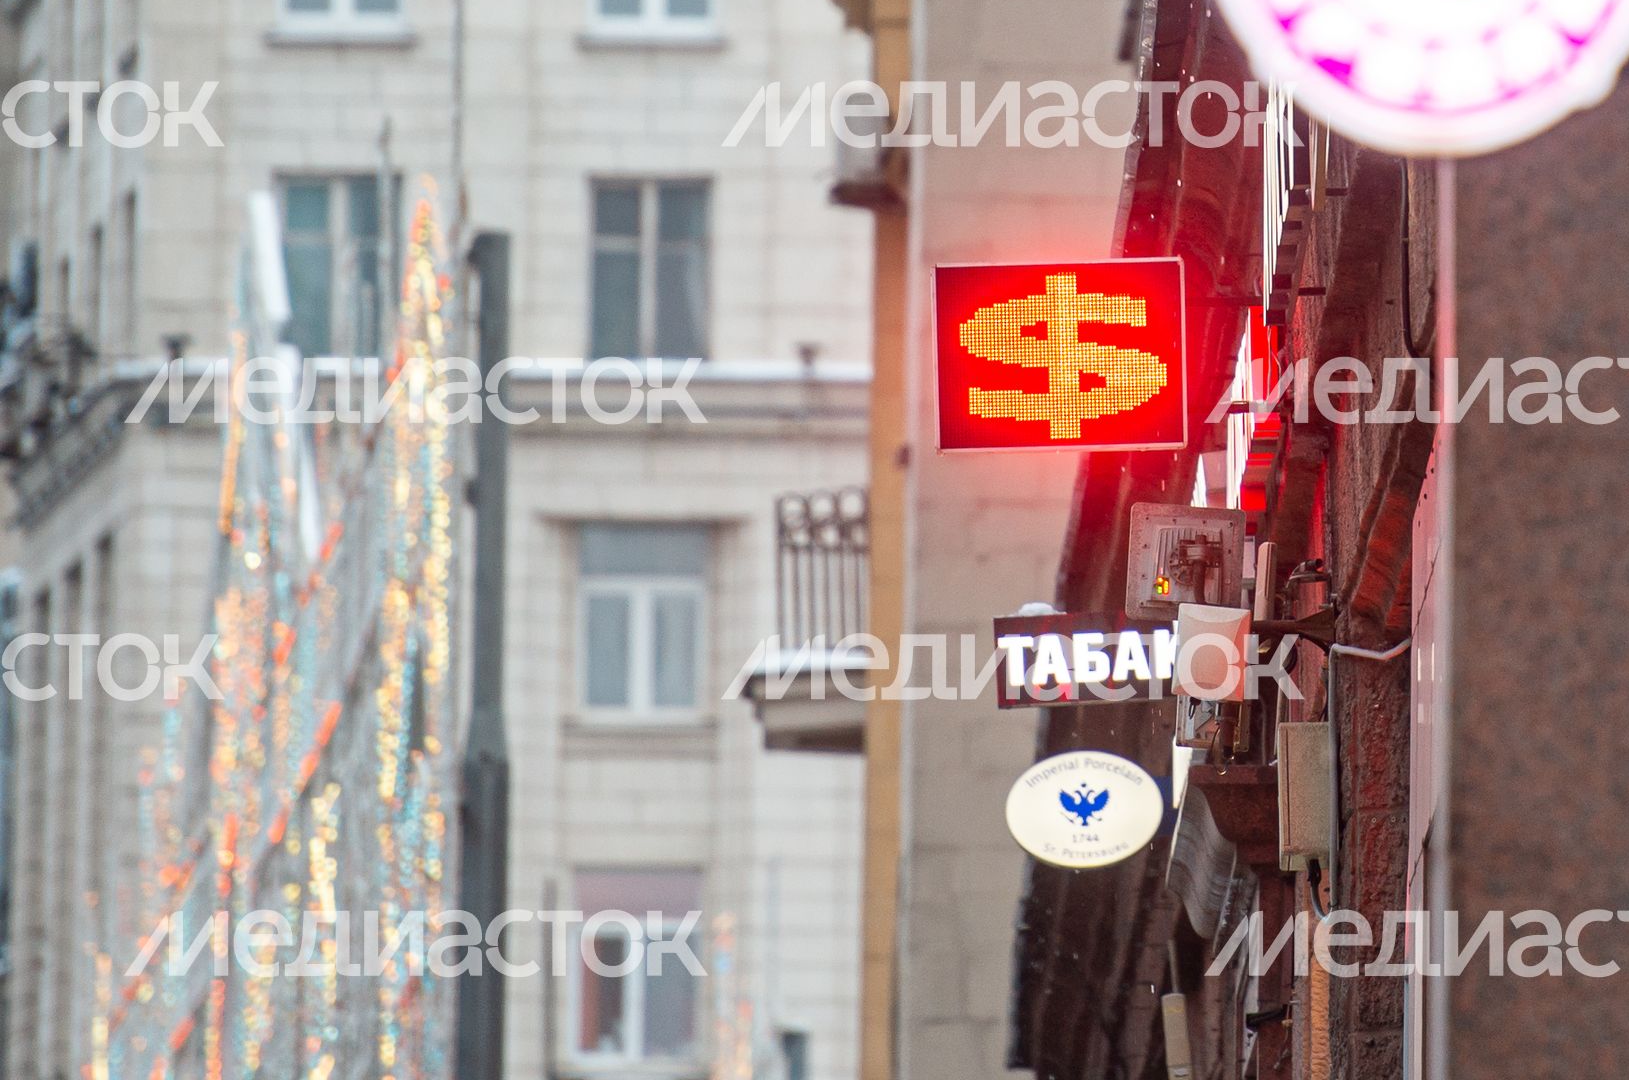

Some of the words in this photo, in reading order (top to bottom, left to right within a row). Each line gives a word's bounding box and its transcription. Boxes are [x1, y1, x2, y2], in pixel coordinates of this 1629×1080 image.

[1025, 757, 1080, 788] Imperial
[1083, 757, 1144, 786] Porcelain
[1072, 833, 1100, 844] 1744
